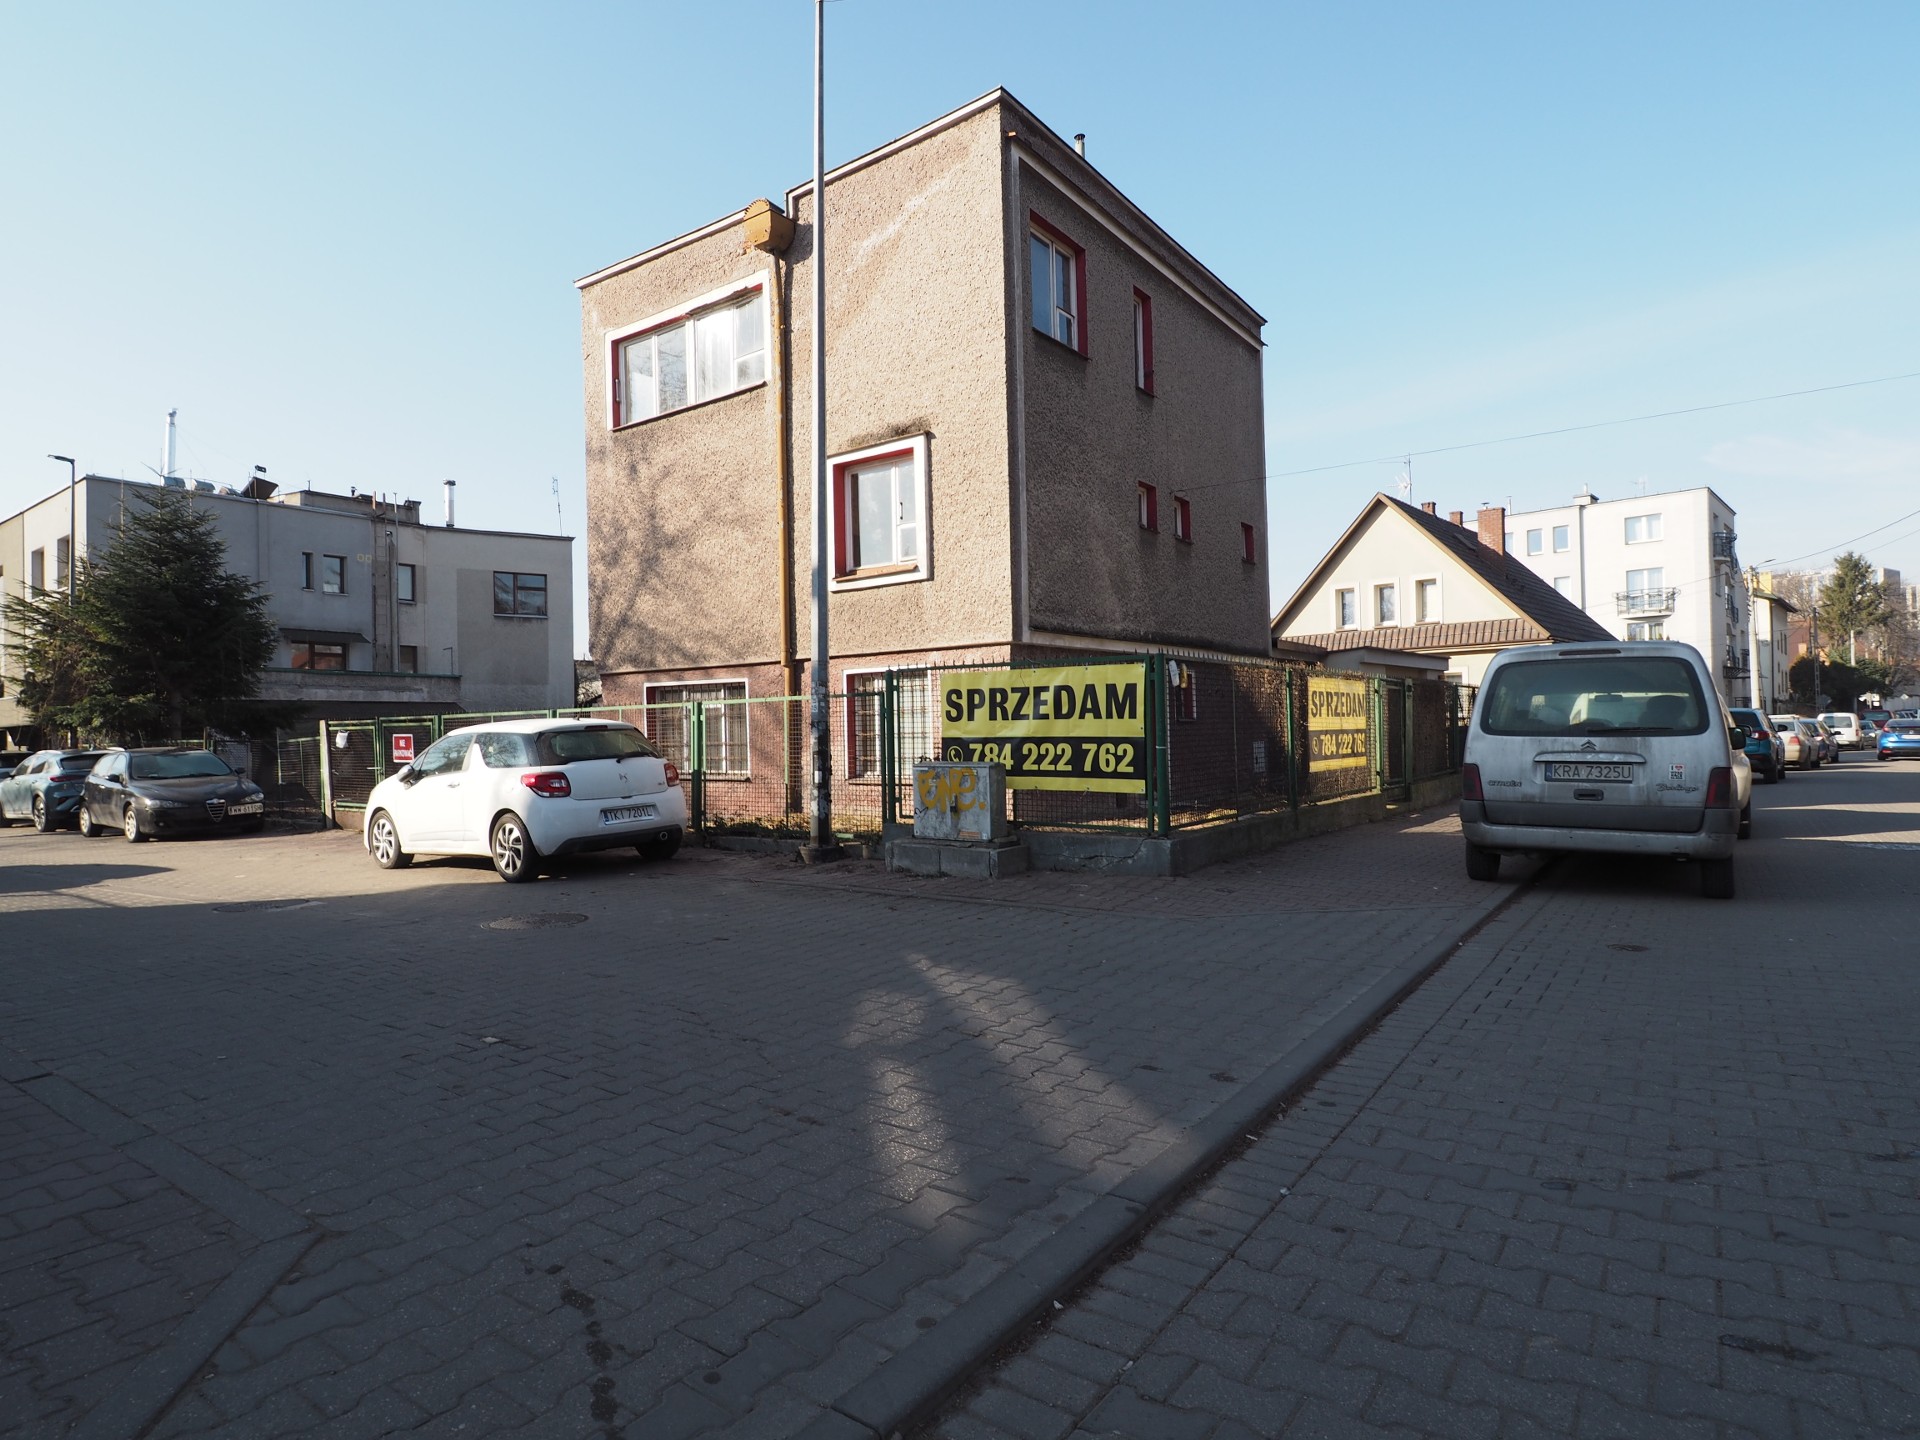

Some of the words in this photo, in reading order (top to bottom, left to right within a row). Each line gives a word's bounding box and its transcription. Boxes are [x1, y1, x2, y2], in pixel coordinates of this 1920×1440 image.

[946, 683, 1137, 722] SPRZEDAM
[1320, 734, 1337, 756] 784
[1338, 733, 1353, 754] 222
[969, 743, 1014, 770] 784
[1022, 743, 1072, 771] 222
[1082, 743, 1134, 773] 762
[1552, 765, 1580, 778] KRA
[1586, 765, 1631, 779] 7325U
[608, 810, 625, 821] TKI
[627, 807, 653, 819] 7201L
